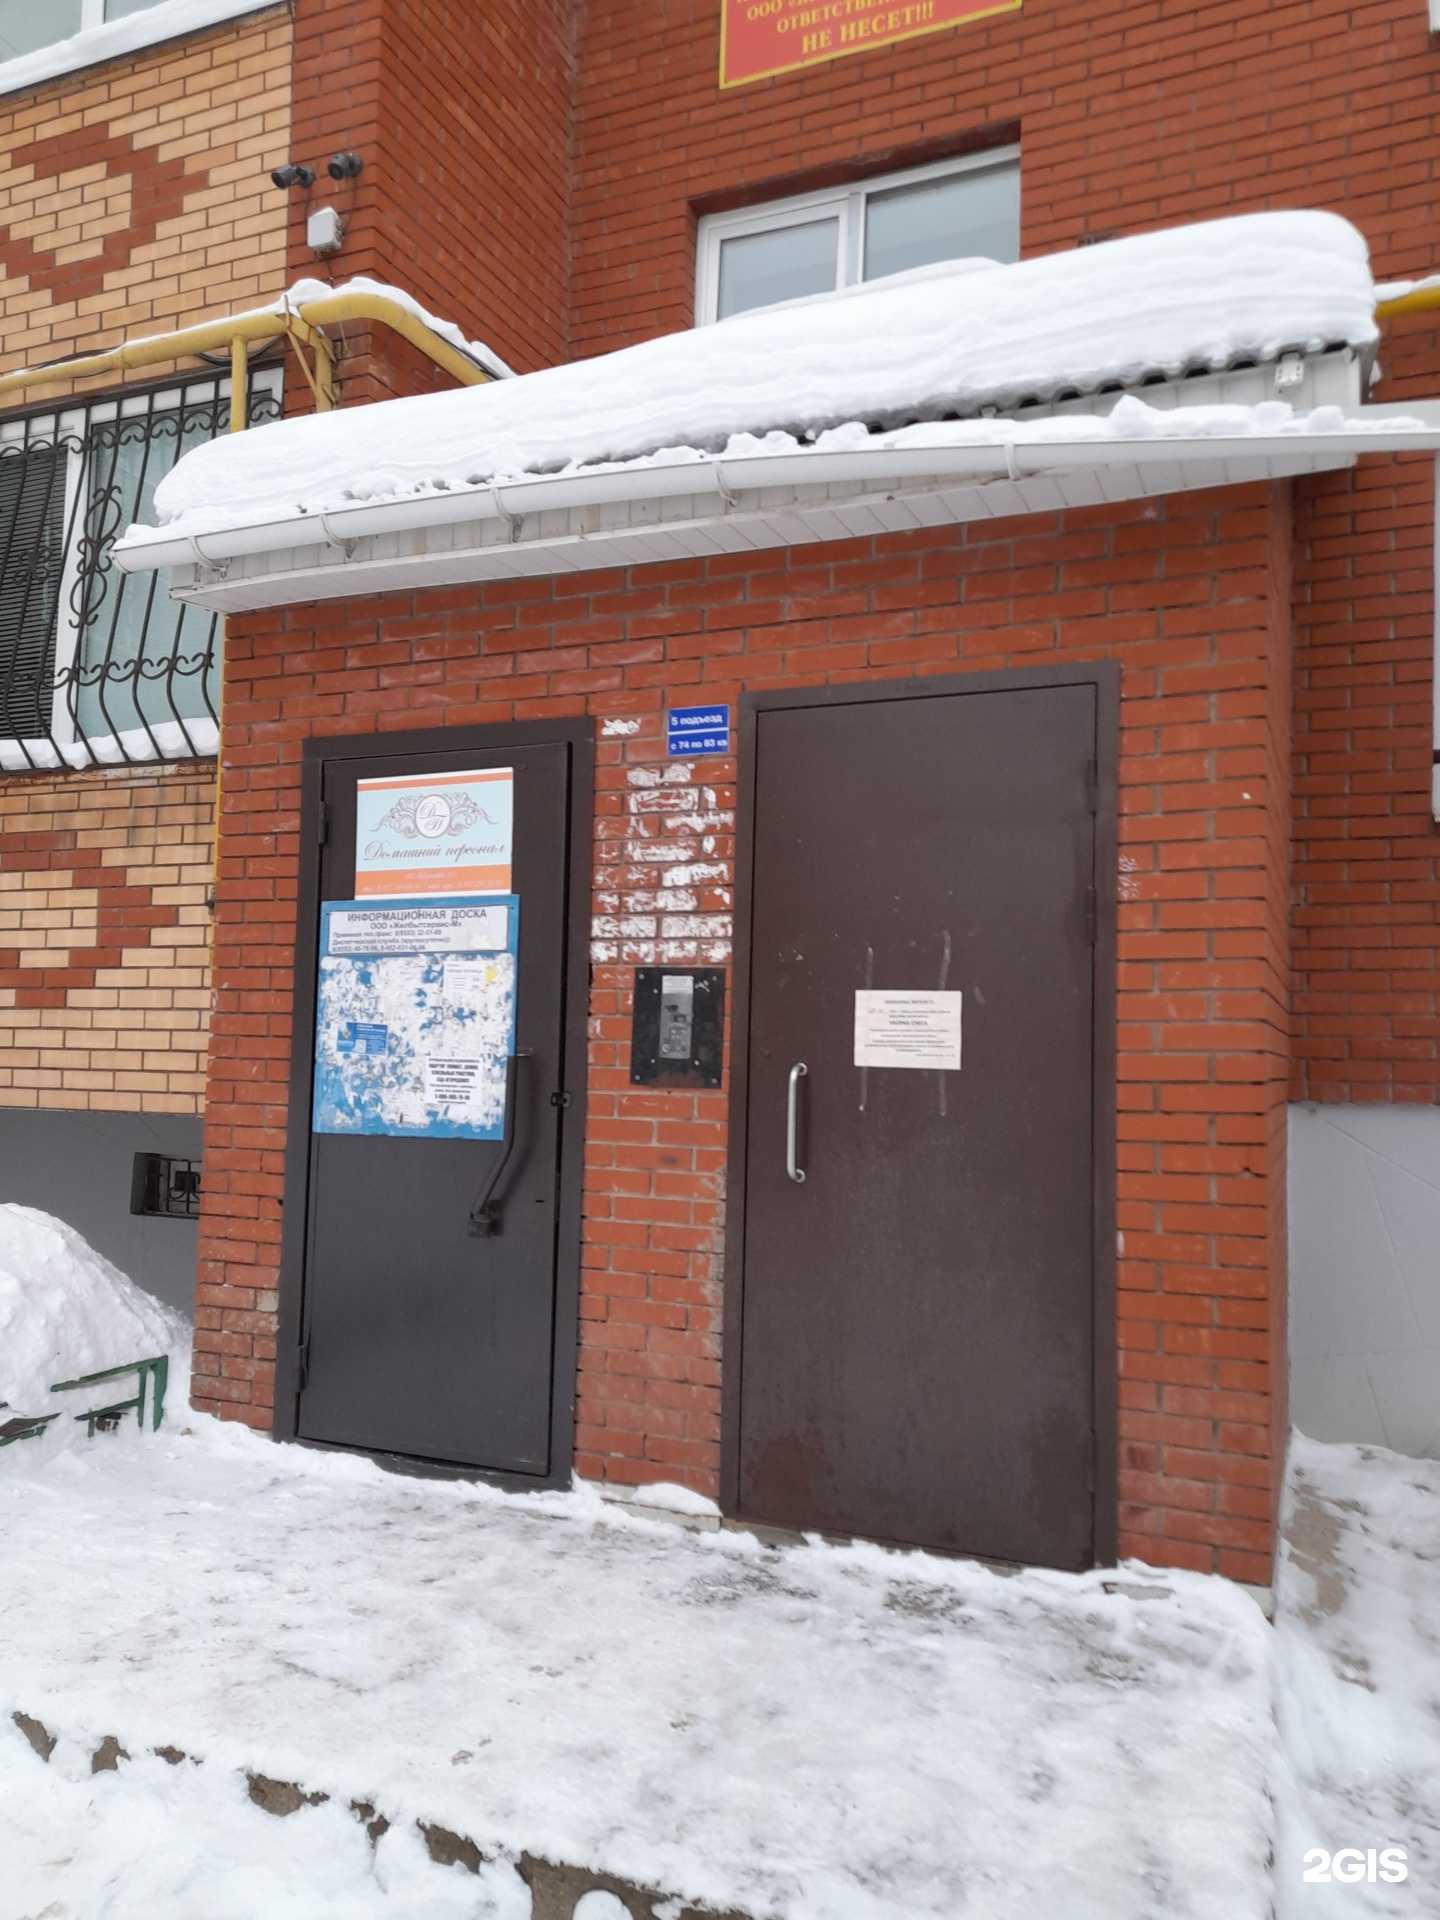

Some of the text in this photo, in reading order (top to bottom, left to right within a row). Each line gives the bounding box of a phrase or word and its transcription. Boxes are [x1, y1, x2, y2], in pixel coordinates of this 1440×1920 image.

[802, 0, 935, 54] НЕ НЕСЕТ!!!
[347, 908, 487, 922] ИНФОРМАЦИОННАЯ ДОСКА
